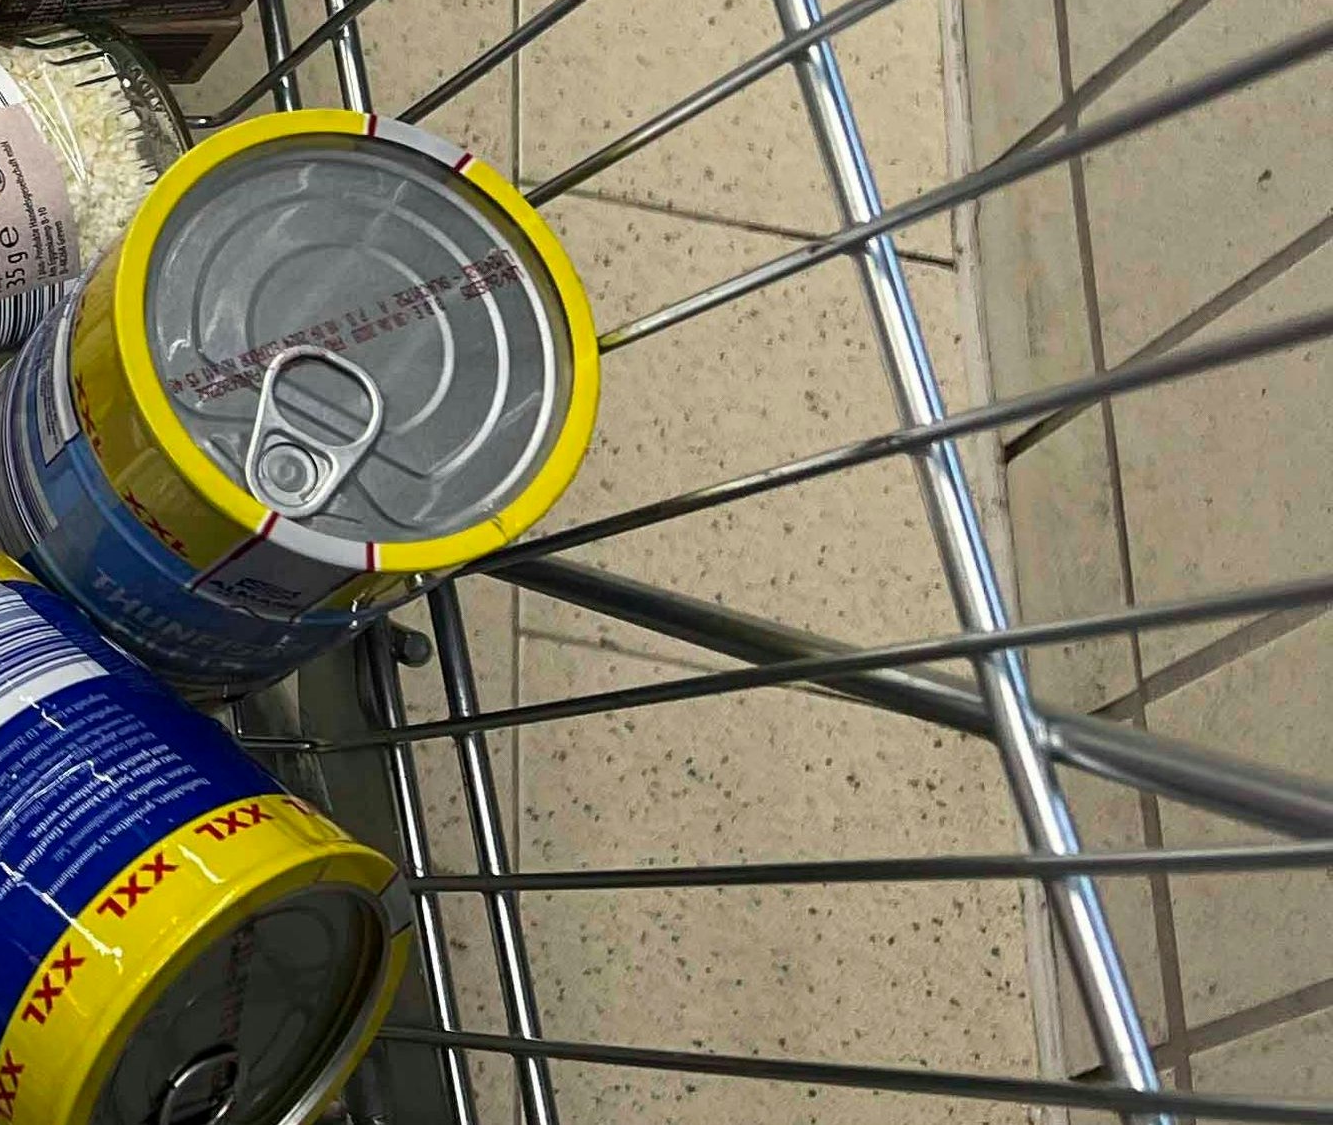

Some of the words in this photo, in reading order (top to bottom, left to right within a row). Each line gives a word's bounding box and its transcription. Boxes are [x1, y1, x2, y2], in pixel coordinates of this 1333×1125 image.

[7, 266, 25, 288] 35
[196, 803, 268, 841] XXL
[97, 853, 176, 918] XXL
[21, 945, 84, 1024] XXL
